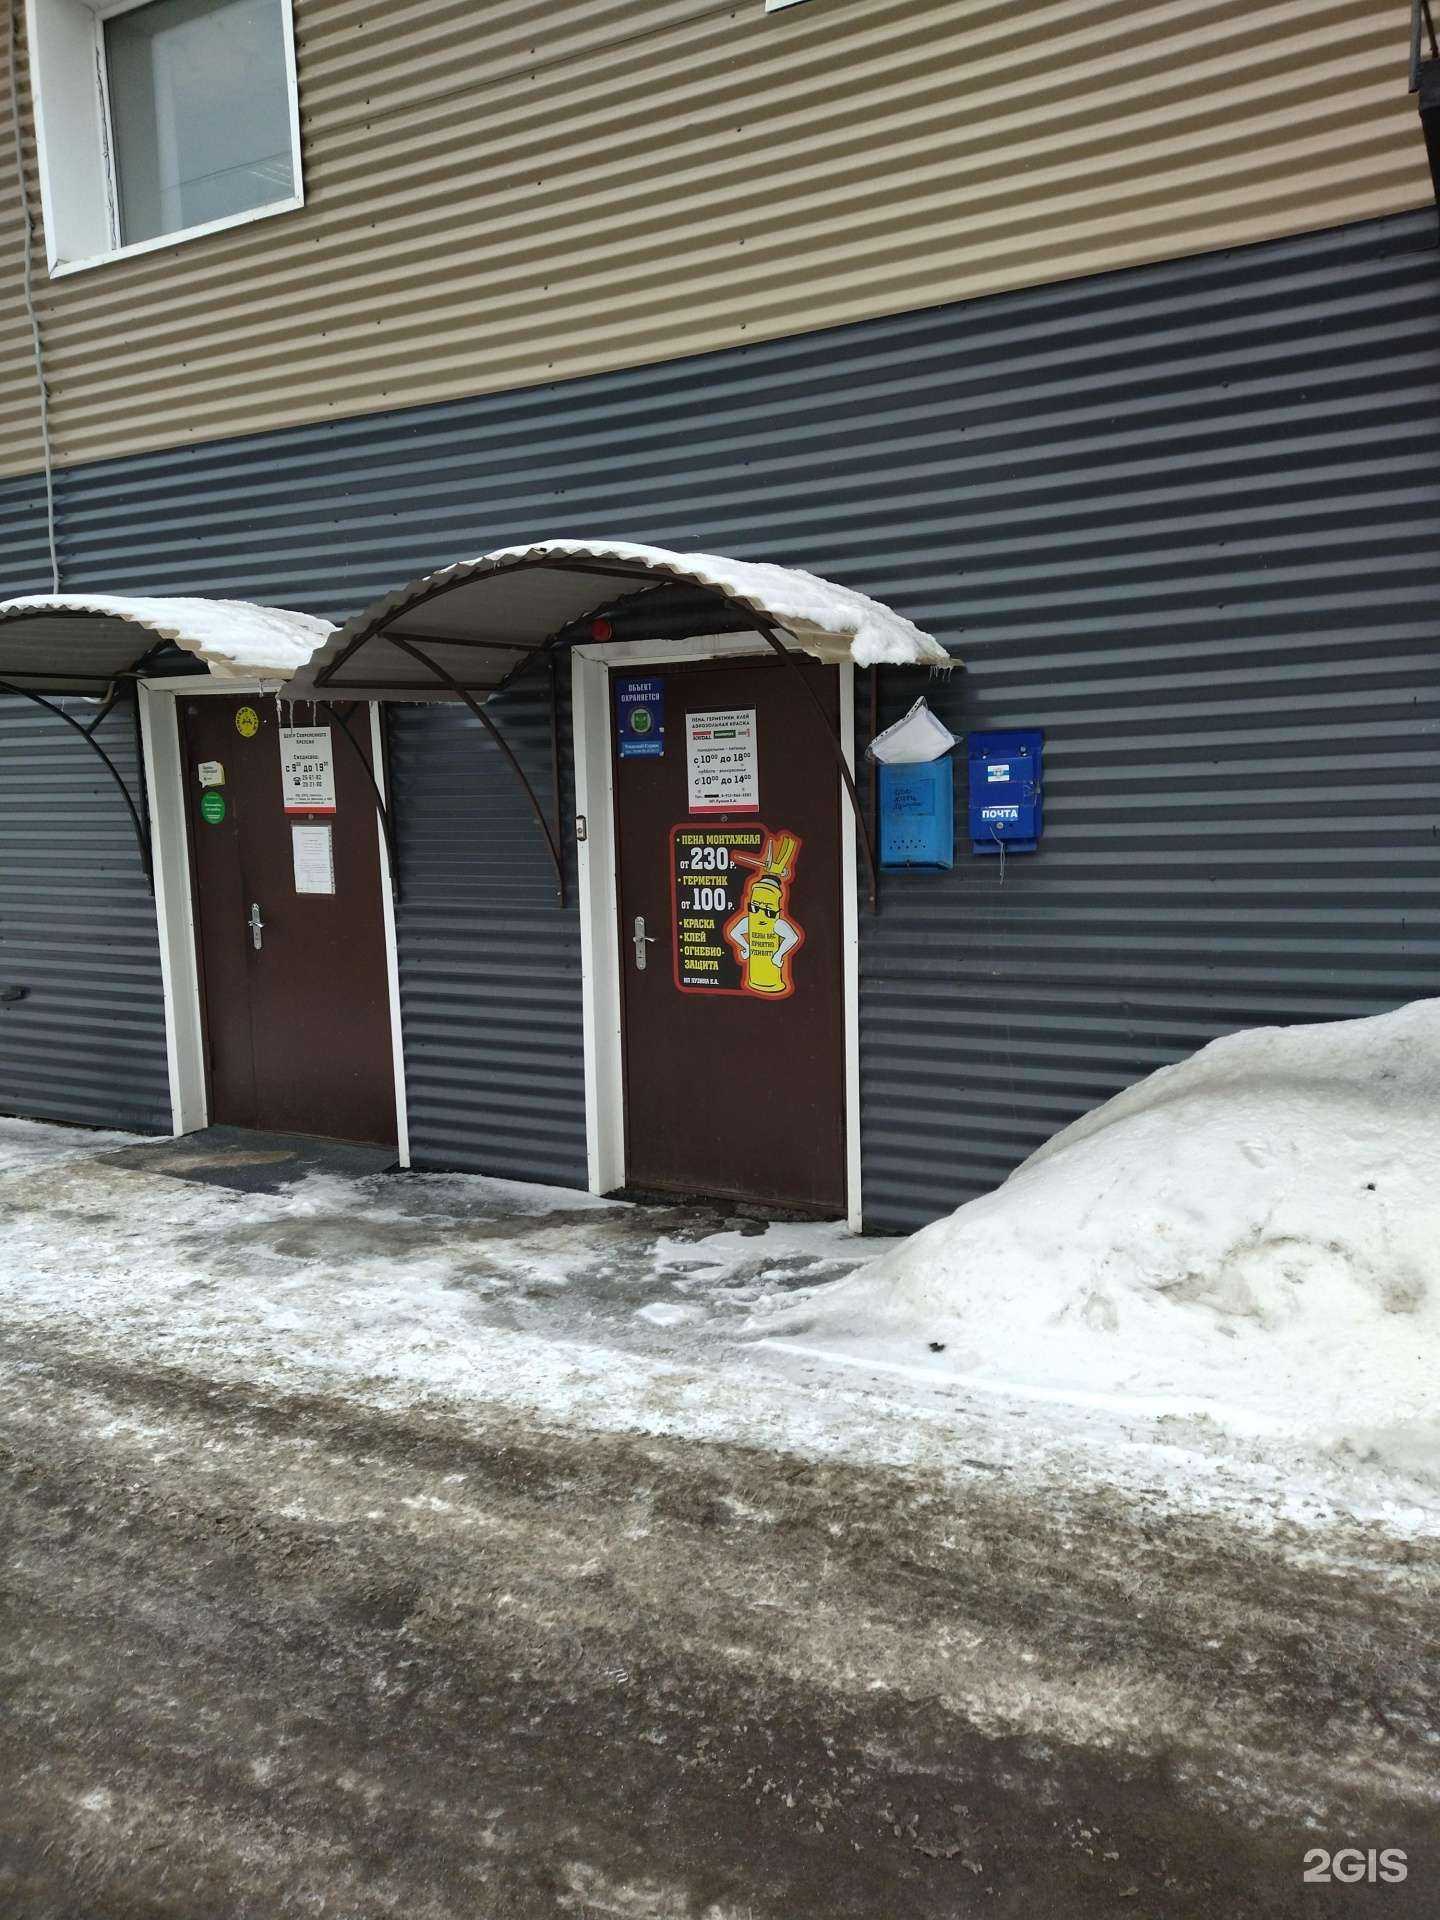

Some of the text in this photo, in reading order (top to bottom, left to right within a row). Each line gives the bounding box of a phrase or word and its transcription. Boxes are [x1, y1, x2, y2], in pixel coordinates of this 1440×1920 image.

[628, 683, 651, 692] ОБЪЕКТ
[621, 693, 660, 702] ОХРАНЯЕТСЯ
[691, 721, 728, 729] АЭРОЗОЛЬНАЯ
[303, 764, 313, 773] до
[720, 777, 732, 785] до
[982, 809, 1018, 819] ПОЧТА
[681, 834, 761, 845] ПЕНА МОНТАЖНАЯ
[680, 860, 689, 869] ОТ
[690, 847, 729, 870] 230
[683, 875, 728, 886] ГЕРМЕТИК
[681, 901, 690, 910] ОТ
[693, 887, 726, 911] 100
[683, 918, 715, 929] КРАСКА
[683, 931, 707, 943] КЛЕЙ
[684, 945, 725, 957] ОГНЕБИО-
[685, 959, 719, 971] ЗАЩИТА
